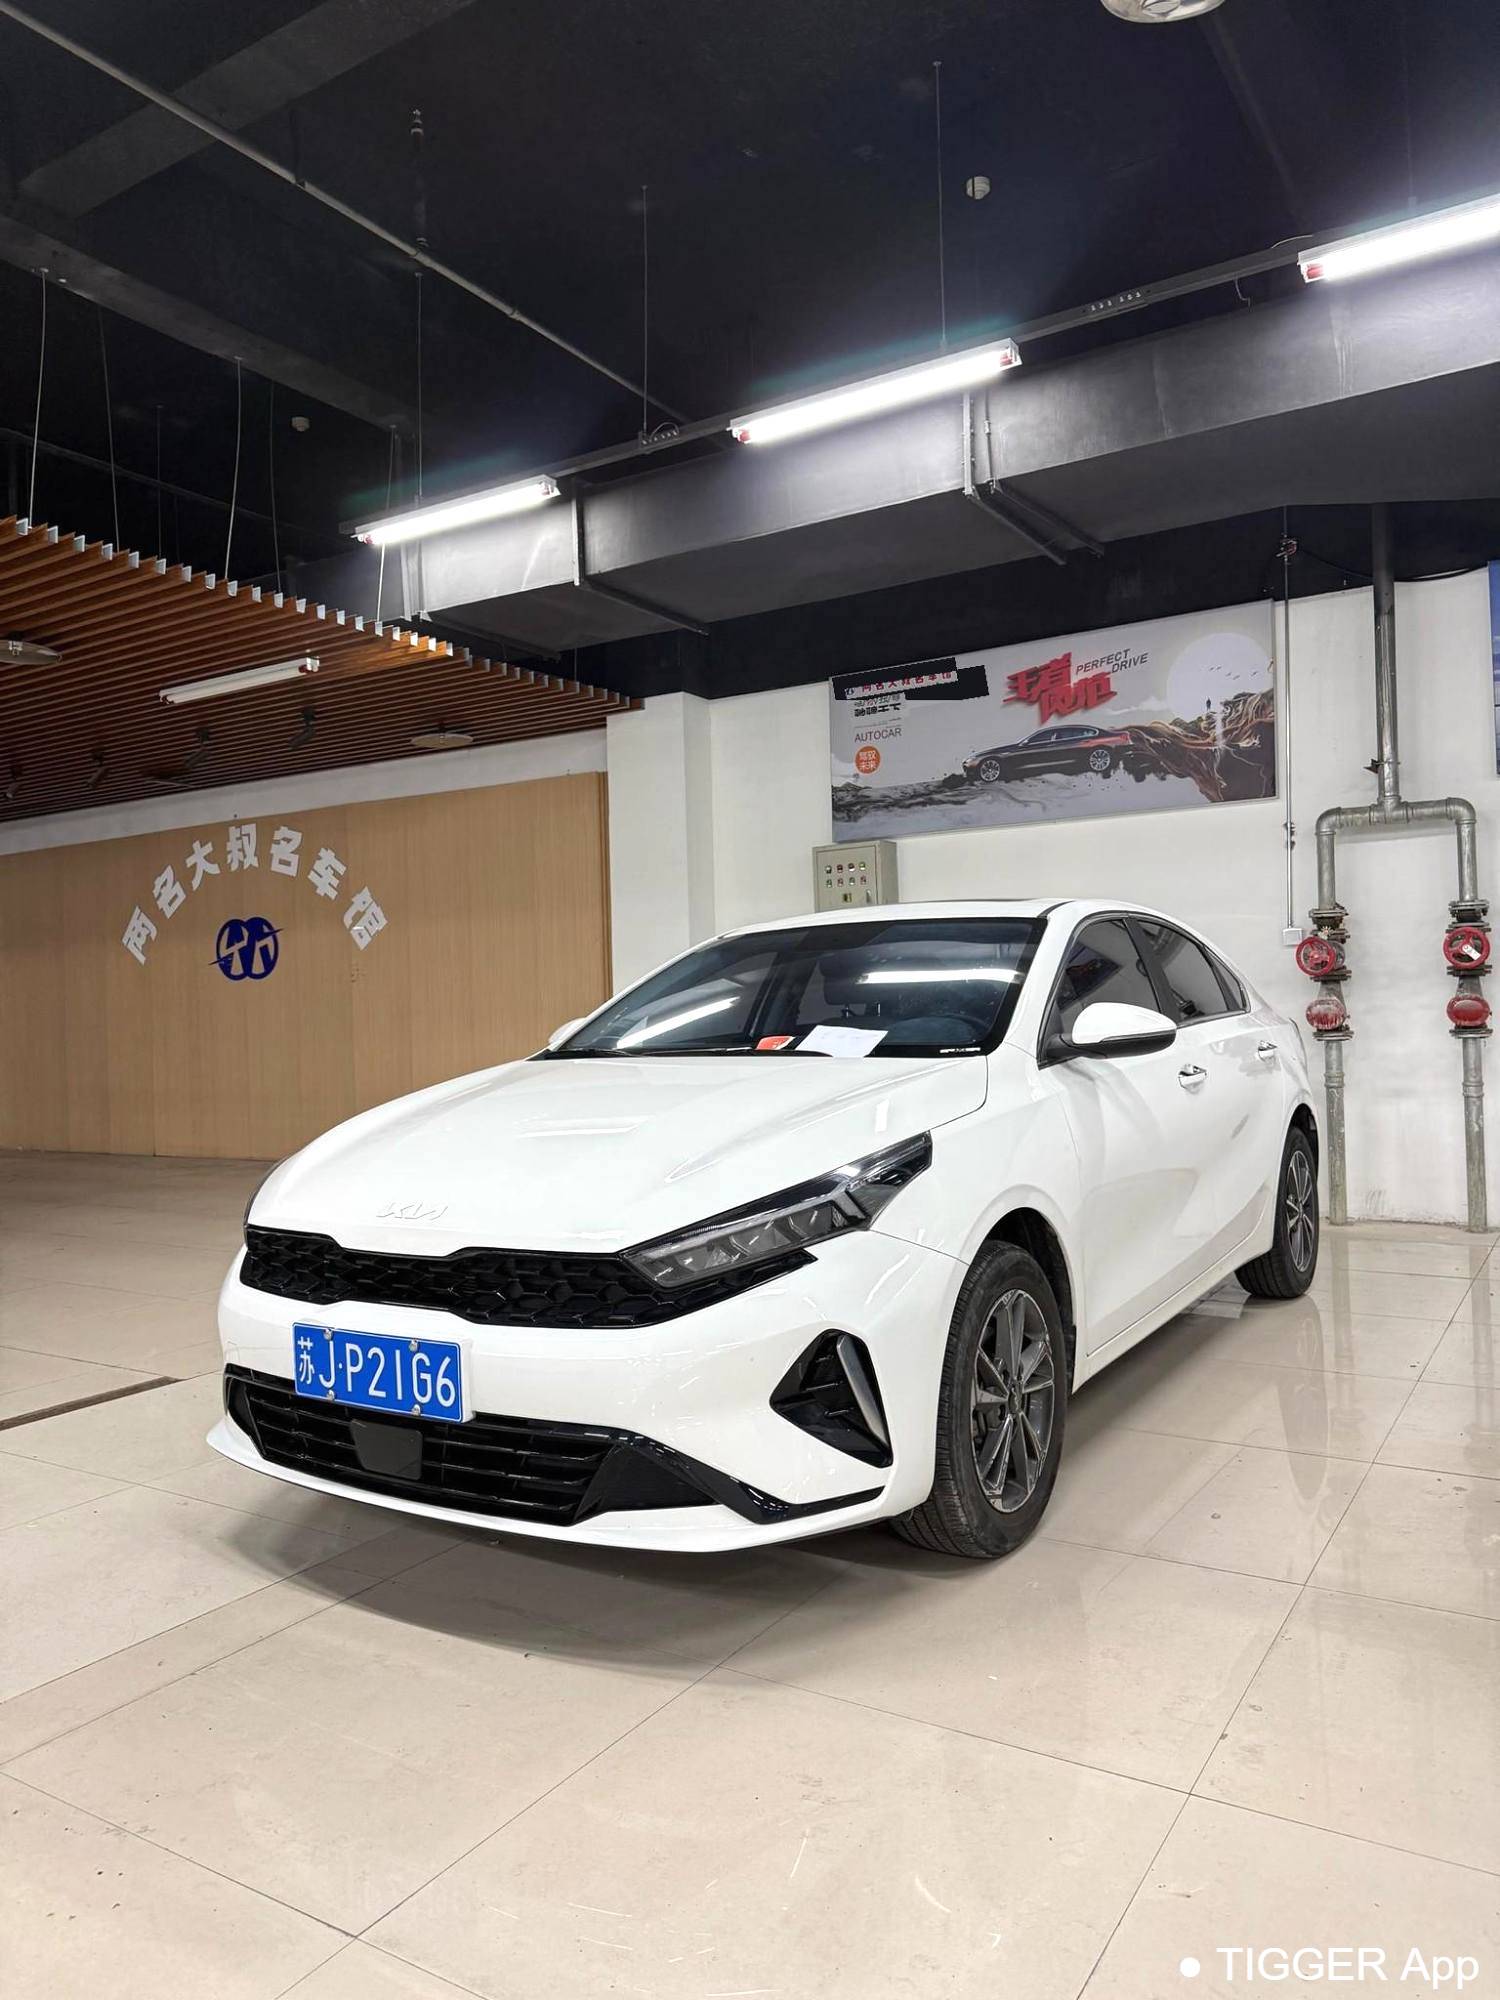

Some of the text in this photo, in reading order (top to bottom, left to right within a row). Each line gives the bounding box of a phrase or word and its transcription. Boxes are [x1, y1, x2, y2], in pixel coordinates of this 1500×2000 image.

[1076, 649, 1130, 675] PERFECT
[1111, 652, 1149, 674] DRIVE
[854, 728, 902, 743] AUTOCAR
[122, 823, 388, 965] 两名大叔名车馆
